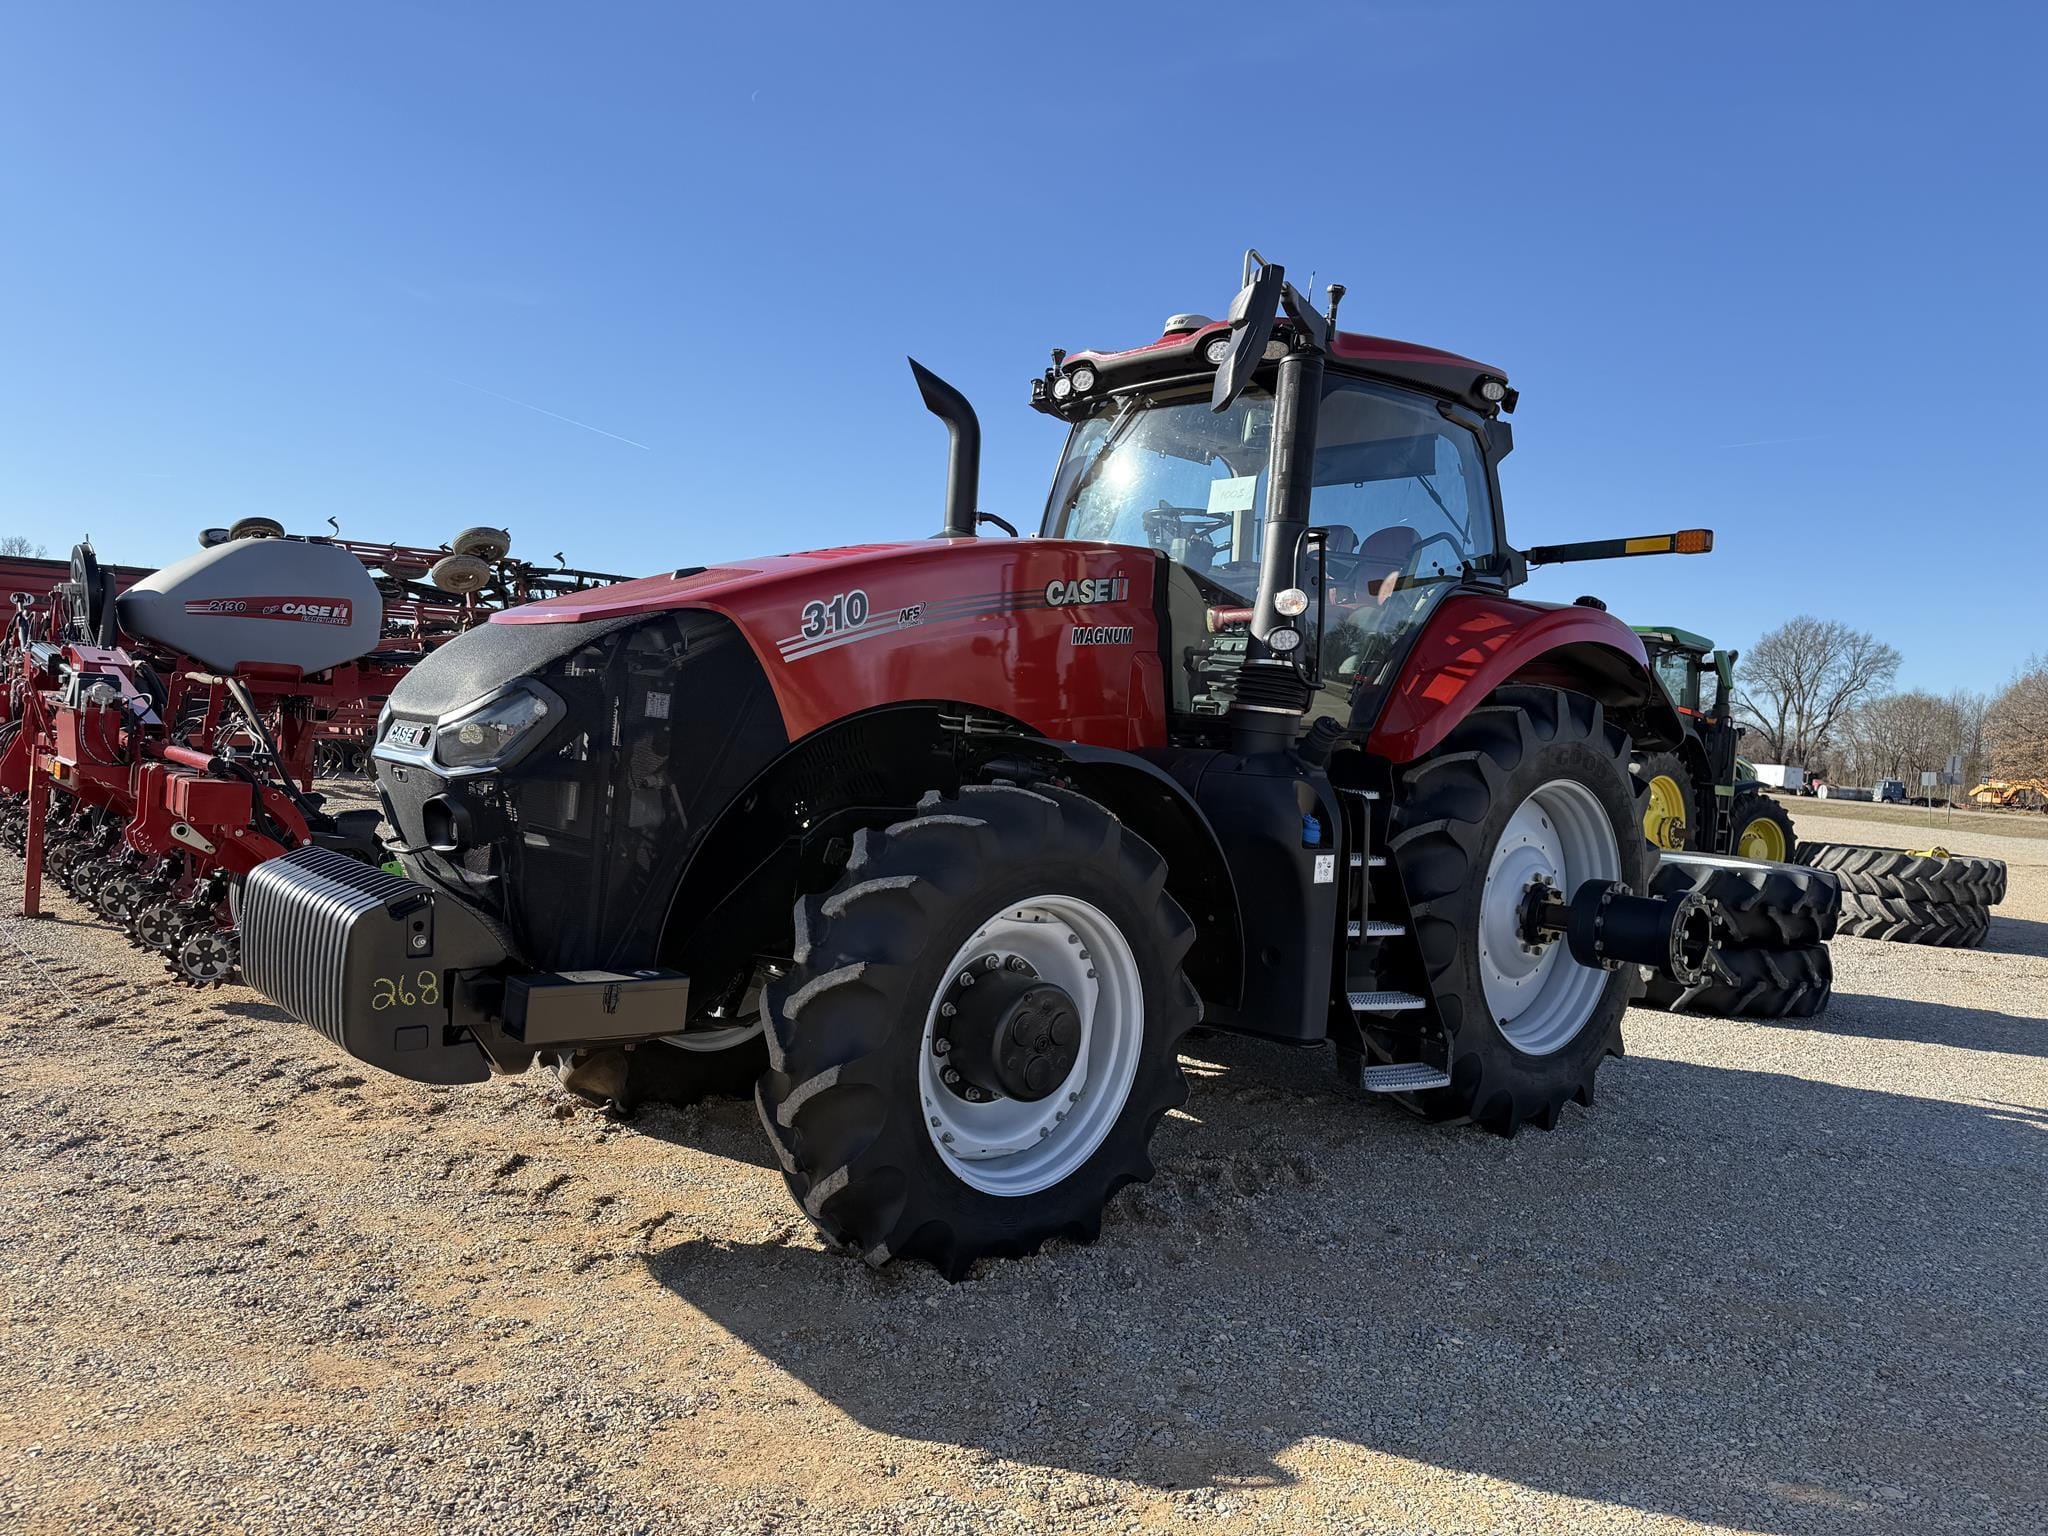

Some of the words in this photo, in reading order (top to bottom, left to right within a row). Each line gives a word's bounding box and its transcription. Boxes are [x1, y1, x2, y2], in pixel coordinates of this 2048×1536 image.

[1046, 579, 1110, 606] CASE
[208, 600, 246, 613] 2130
[282, 603, 331, 616] CASE
[801, 589, 869, 640] 310
[899, 605, 921, 623] AFS
[1071, 627, 1133, 645] MAGNUM
[372, 970, 438, 1010] 268
